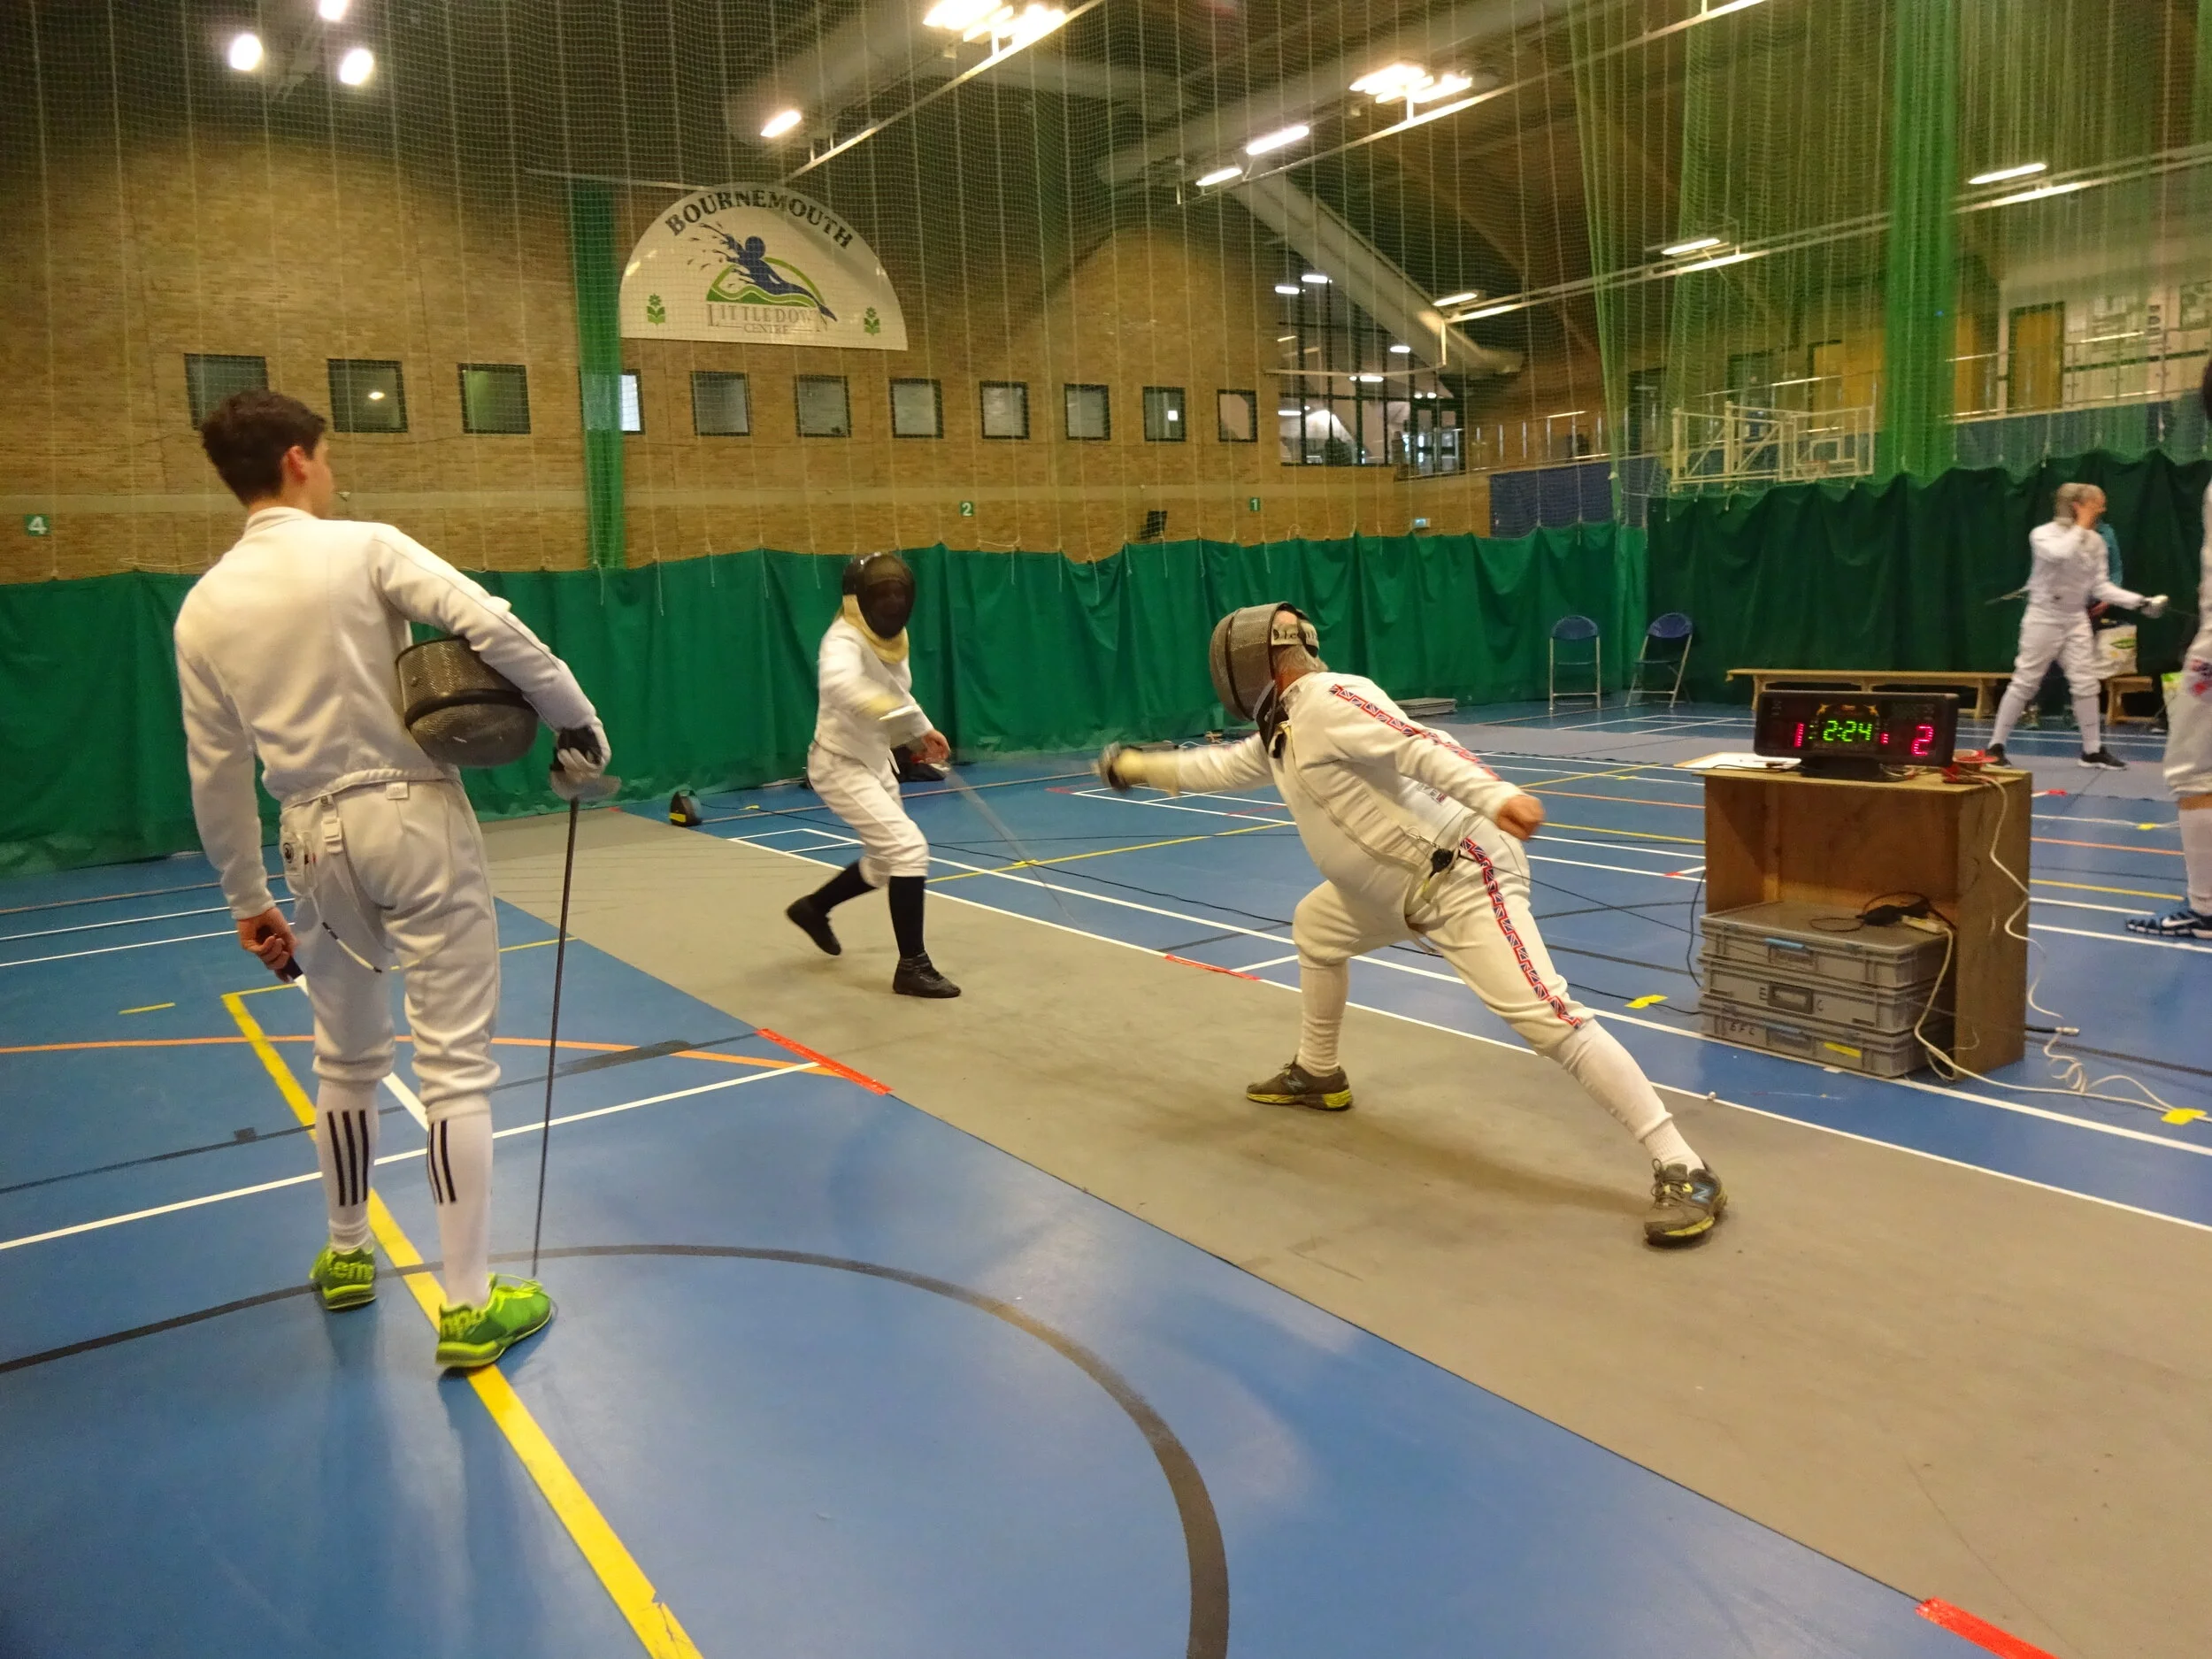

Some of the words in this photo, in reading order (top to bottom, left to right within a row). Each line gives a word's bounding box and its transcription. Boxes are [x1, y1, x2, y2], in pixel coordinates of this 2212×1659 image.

[664, 188, 854, 250] BOURNEMOUTH
[706, 303, 828, 333] LITTLEDOWN
[743, 323, 789, 334] CENTRE
[961, 502, 972, 517] 2
[1250, 498, 1259, 511] 1
[27, 515, 48, 535] 4
[1793, 722, 1805, 749] 1
[1822, 719, 1873, 741] 2:24
[1910, 724, 1934, 757] 2
